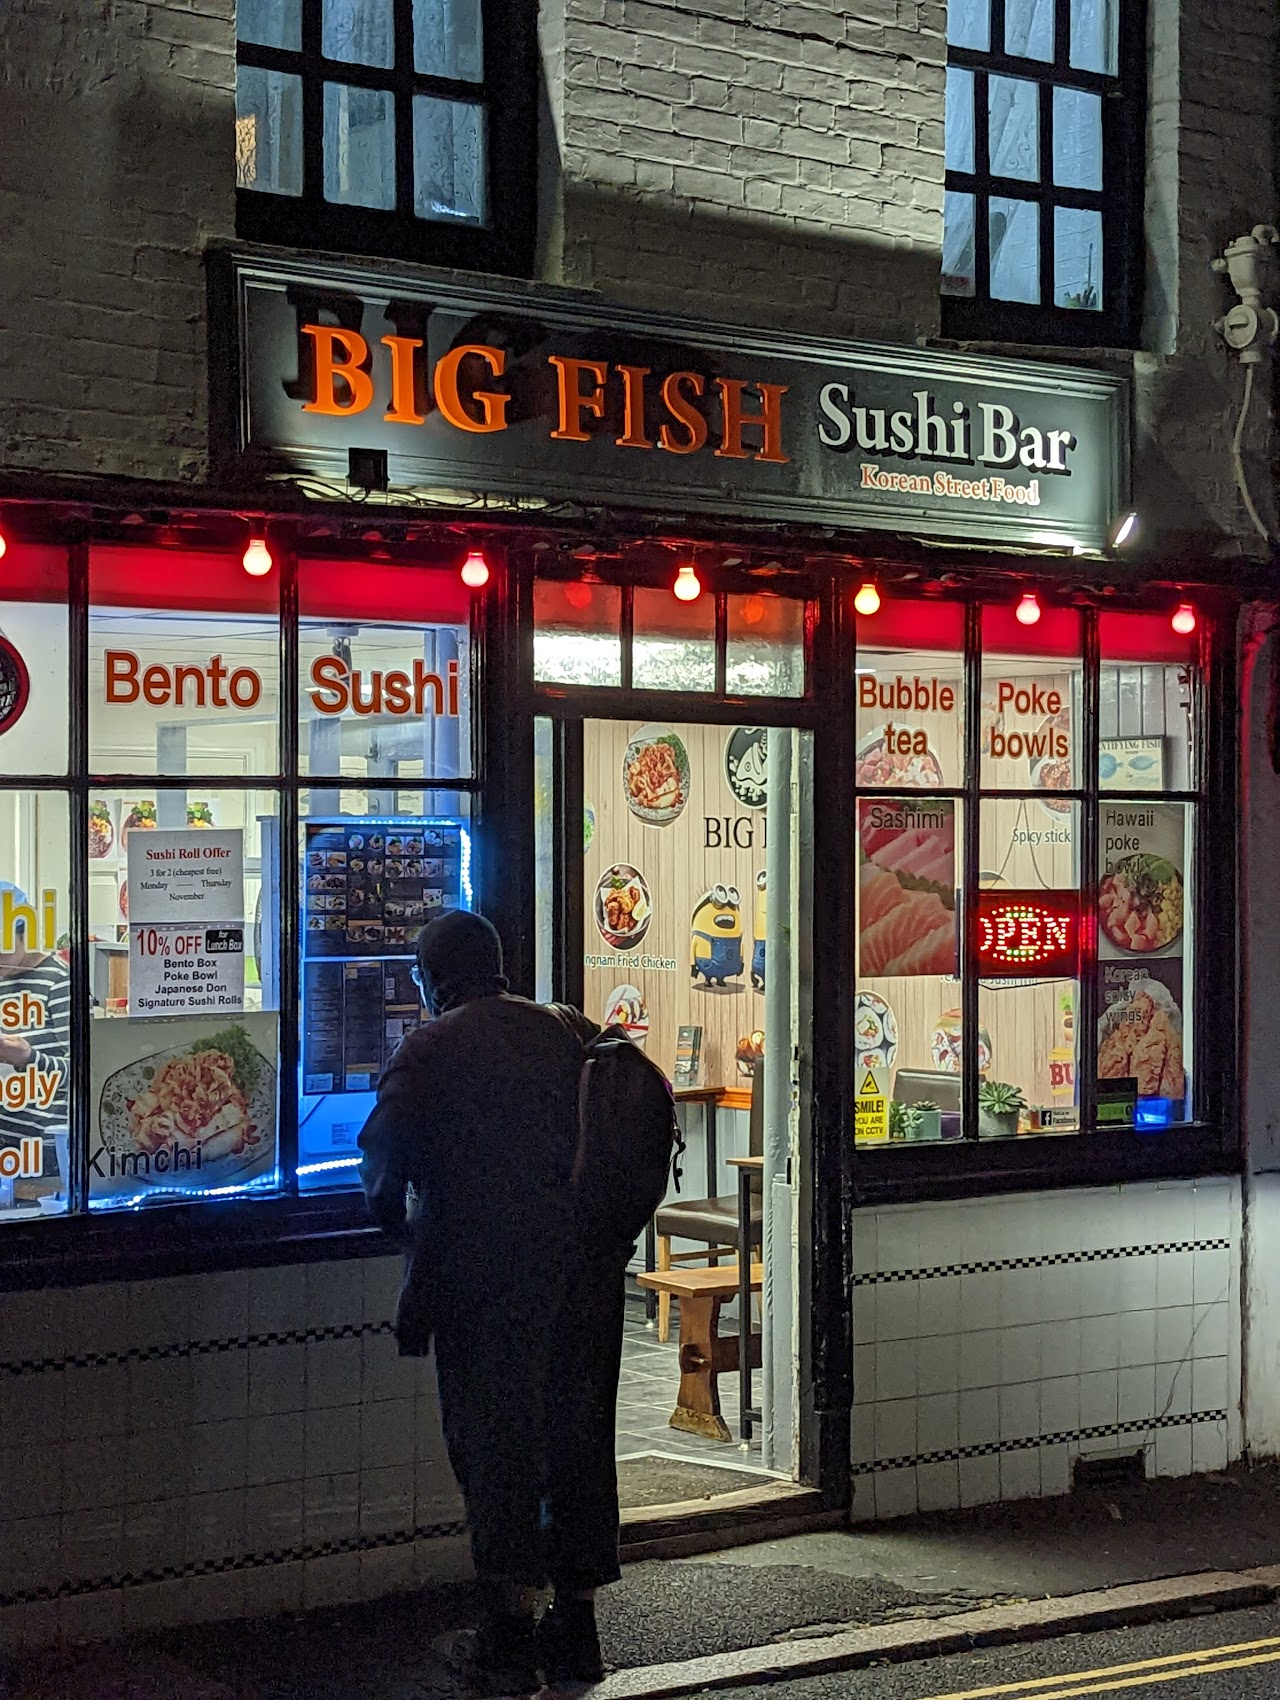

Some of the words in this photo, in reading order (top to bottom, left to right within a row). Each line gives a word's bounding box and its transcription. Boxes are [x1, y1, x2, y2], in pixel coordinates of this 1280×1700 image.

[301, 323, 511, 433] BIG
[548, 355, 791, 464] FISH
[818, 382, 969, 459] Sushi
[977, 402, 1072, 471] Bar
[860, 464, 931, 493] Korean
[934, 471, 988, 497] Street
[991, 477, 1040, 504] Food
[105, 649, 262, 710] Bento
[310, 654, 459, 717] Sushi
[859, 675, 954, 711] Bubble
[998, 682, 1061, 715] Poke
[884, 721, 928, 756] tea
[990, 726, 1069, 758] bowls
[870, 808, 944, 829] Sashimi
[1106, 809, 1154, 827] Hawaii
[703, 816, 754, 849] BIG
[1012, 828, 1042, 847] Spicy
[1045, 829, 1072, 844] stick
[146, 848, 176, 861] Sushi
[179, 847, 201, 860] Roll
[203, 846, 232, 859] Offer
[1106, 834, 1140, 855] poke
[156, 868, 166, 877] for
[167, 868, 172, 877] 2
[140, 881, 168, 891] Monday
[201, 878, 232, 889] Thursday
[169, 892, 205, 901] November
[137, 928, 171, 957] 10%
[175, 935, 203, 956] OFF
[207, 940, 228, 951] Lunch
[229, 939, 242, 951] Box
[164, 959, 195, 969] Bento
[197, 958, 218, 968] Box
[617, 954, 640, 968] Fried
[641, 955, 676, 970] Chicken
[164, 972, 190, 981] Poke
[192, 970, 218, 981] Bowl
[1104, 966, 1149, 983] Korean
[155, 984, 203, 995] Japanese
[206, 983, 227, 993] Don
[138, 998, 186, 1010] Signature
[188, 996, 216, 1006] Sushi
[218, 994, 242, 1005] Rolls
[1106, 1007, 1142, 1024] wings
[855, 1100, 884, 1114] SMILE!
[870, 1116, 883, 1124] ARE
[866, 1127, 884, 1136] CCTV
[88, 1140, 203, 1178] Kimchi
